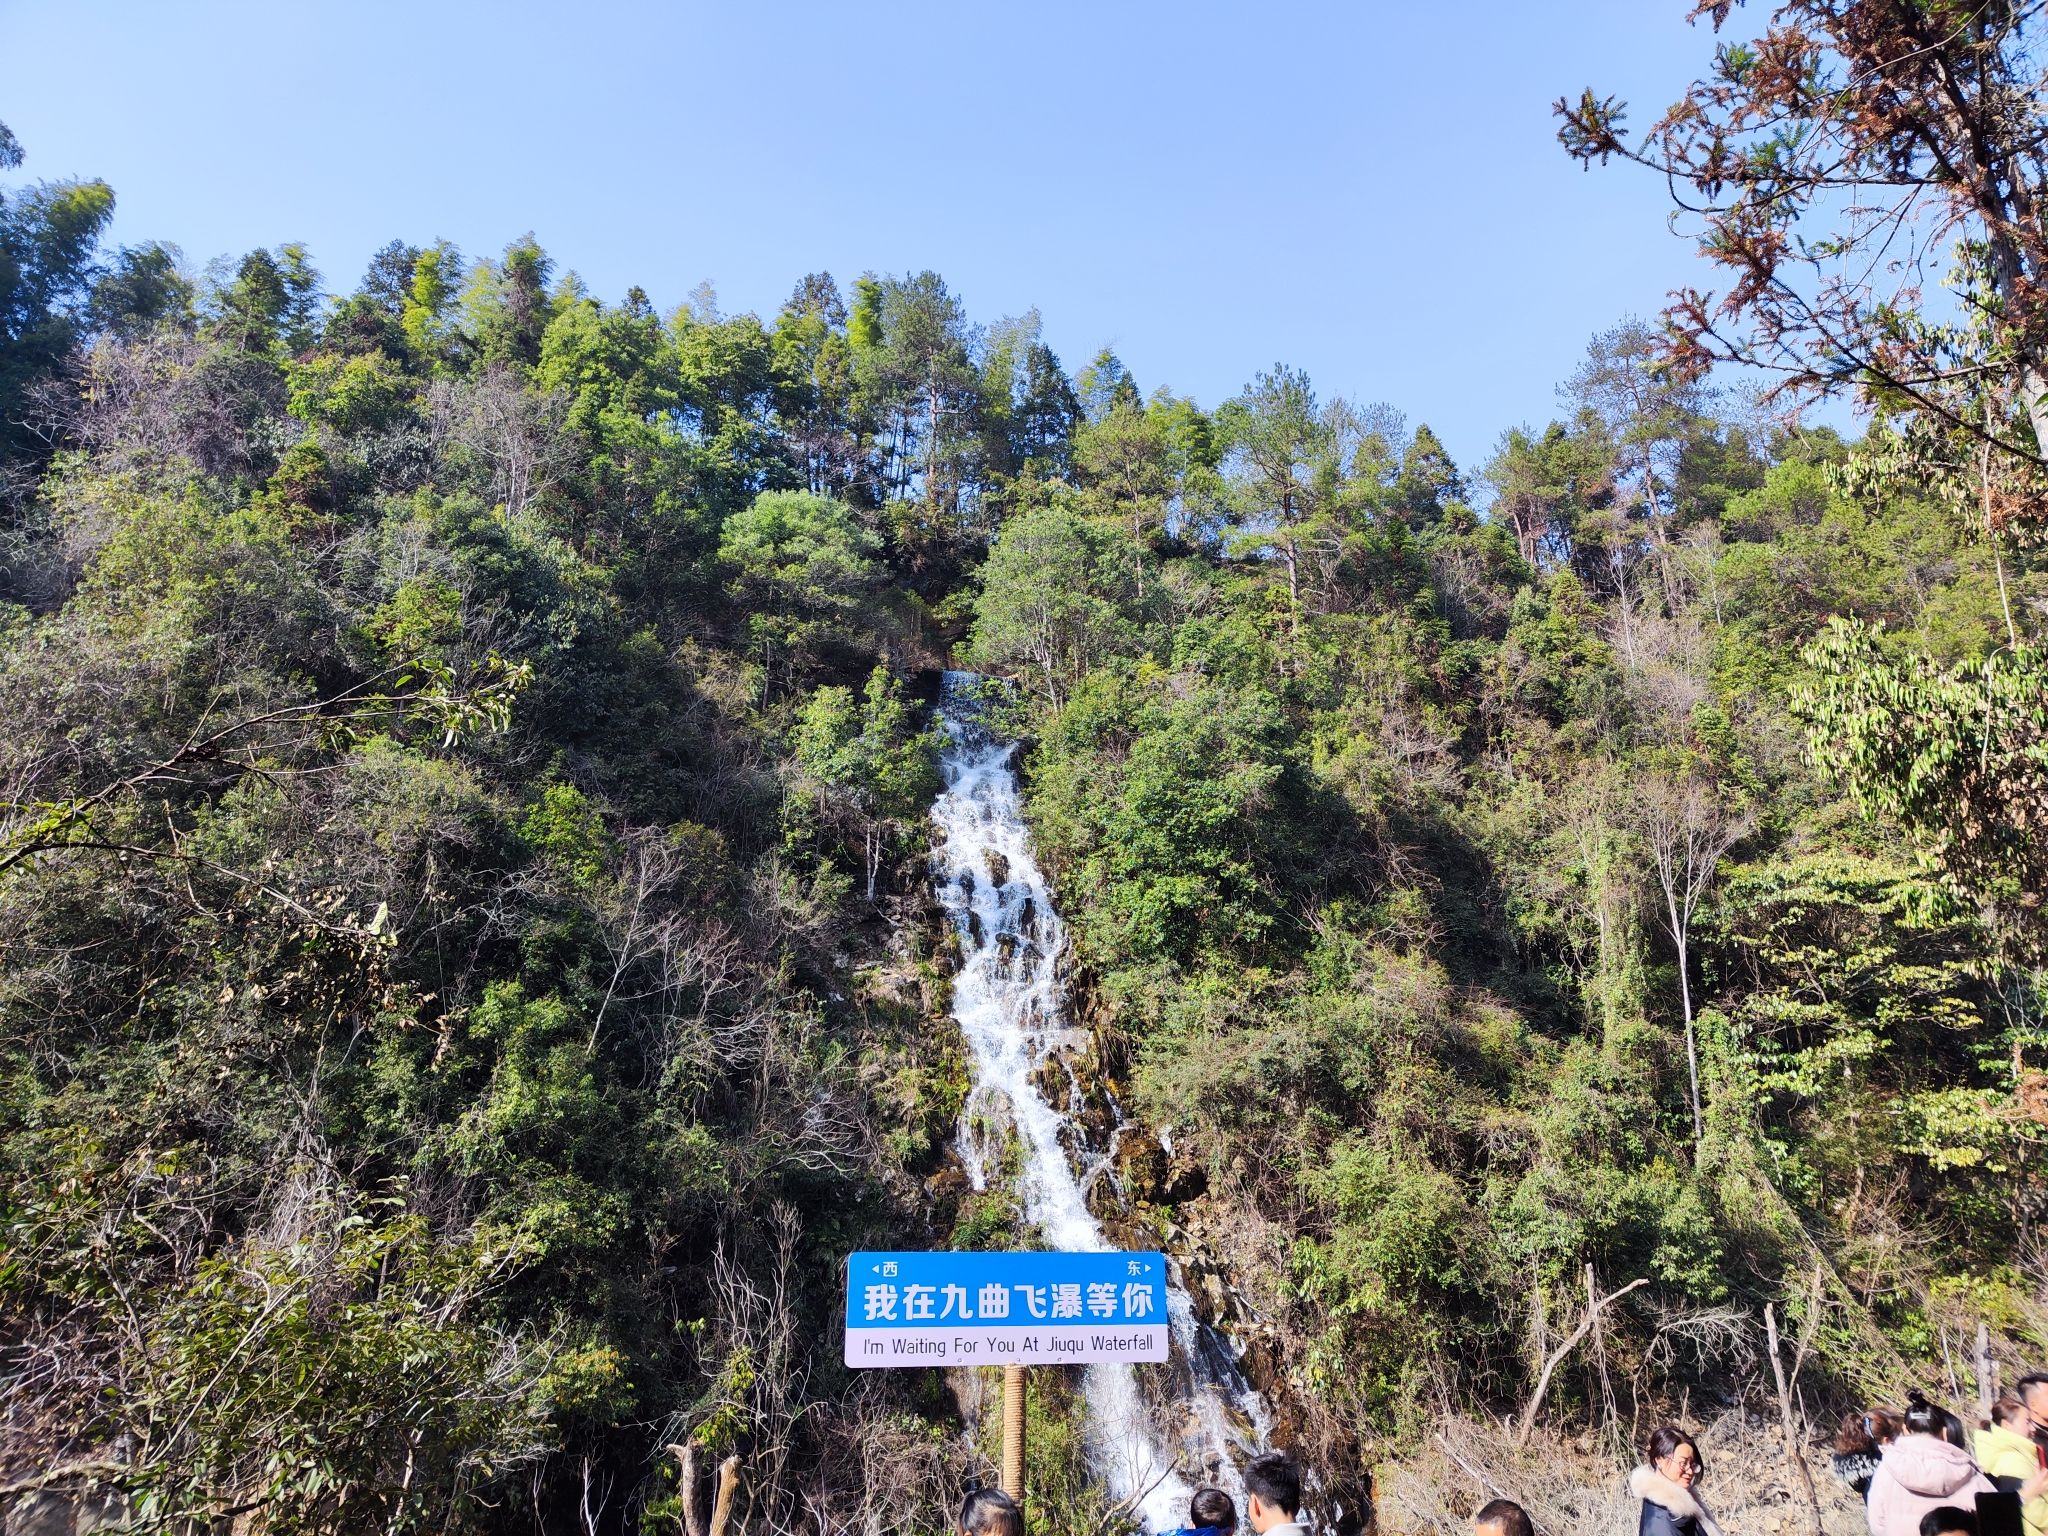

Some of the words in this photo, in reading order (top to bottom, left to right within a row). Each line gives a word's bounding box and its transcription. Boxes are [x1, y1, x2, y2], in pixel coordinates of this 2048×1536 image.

[883, 1262, 898, 1277] 西
[1127, 1260, 1142, 1276] 东
[864, 1282, 1153, 1321] 我在九曲飞瀑等你
[863, 1339, 884, 1354] I'm
[892, 1338, 946, 1357] Waiting
[954, 1338, 978, 1353] For
[986, 1337, 1015, 1353] You
[1022, 1336, 1038, 1352] At
[1046, 1336, 1084, 1355] Jiuqu
[1091, 1334, 1153, 1351] Waterfall
